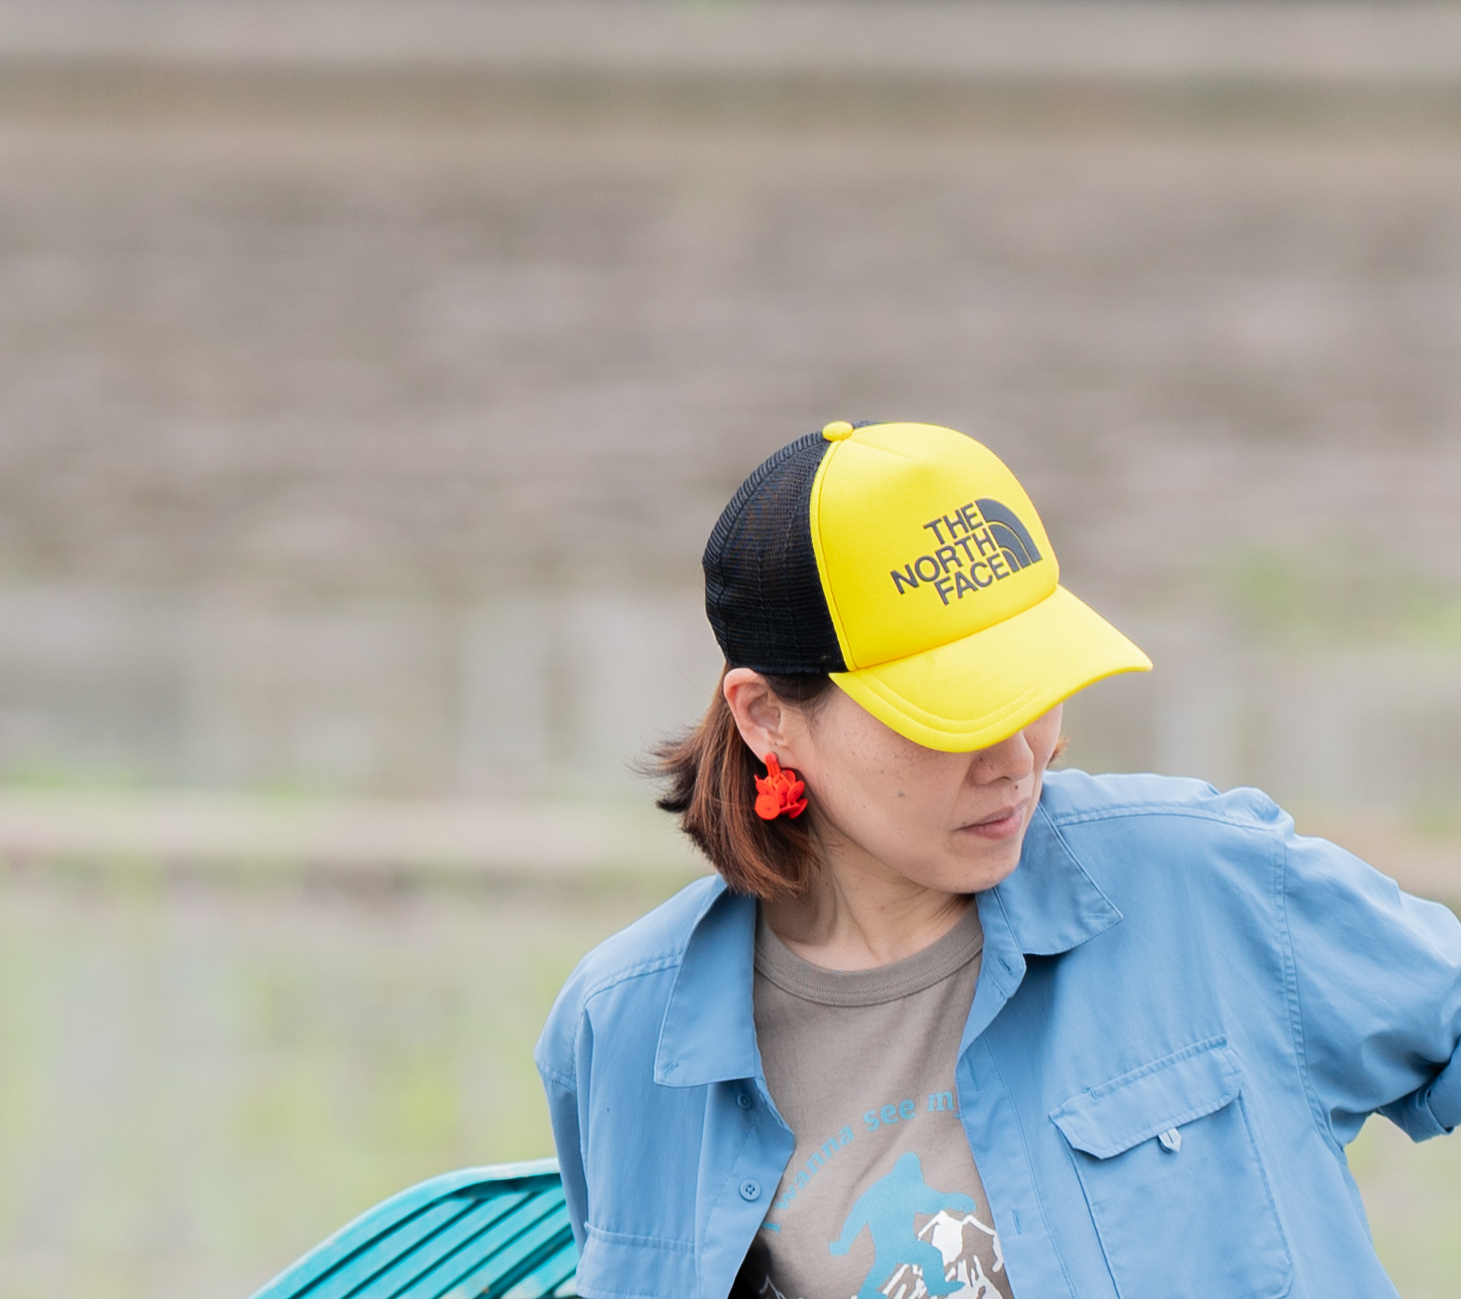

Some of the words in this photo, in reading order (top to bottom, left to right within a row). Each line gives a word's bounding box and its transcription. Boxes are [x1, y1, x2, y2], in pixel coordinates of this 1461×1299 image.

[923, 502, 983, 545] THE
[890, 528, 997, 595] NORTH
[934, 553, 1010, 606] FACE
[775, 1125, 855, 1210] wanna
[863, 1099, 917, 1132] see
[927, 1090, 961, 1119] m
